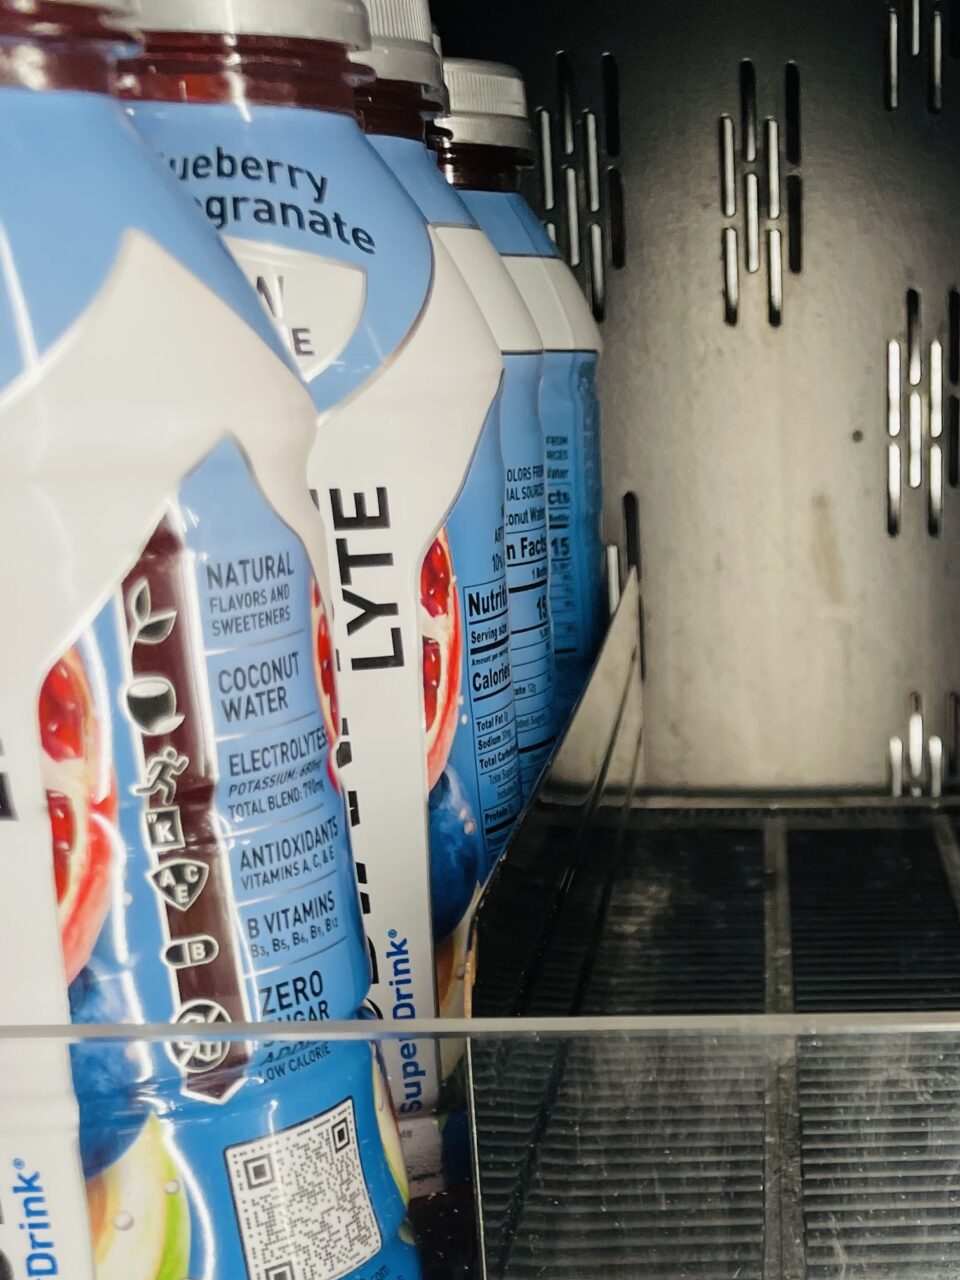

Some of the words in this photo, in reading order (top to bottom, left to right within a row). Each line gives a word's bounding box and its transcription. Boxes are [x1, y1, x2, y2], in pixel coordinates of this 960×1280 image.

[165, 147, 328, 202] ueberry
[200, 198, 376, 255] granate
[206, 552, 294, 590] NATURAL
[329, 487, 404, 671] LYTE
[209, 589, 267, 614] FLAVORS
[270, 583, 290, 600] AND
[212, 606, 291, 637] SWEETENERS
[218, 652, 300, 694] COCONUT
[221, 686, 288, 722] WATER
[229, 725, 328, 777] ELECTROLYTES
[228, 798, 266, 819] TOTAL
[239, 815, 340, 872] ANTIOXIDANTS
[241, 865, 299, 890] VITAMINS
[247, 918, 259, 938] B
[264, 890, 335, 934] VITAMINS
[261, 970, 323, 1016] ZERO
